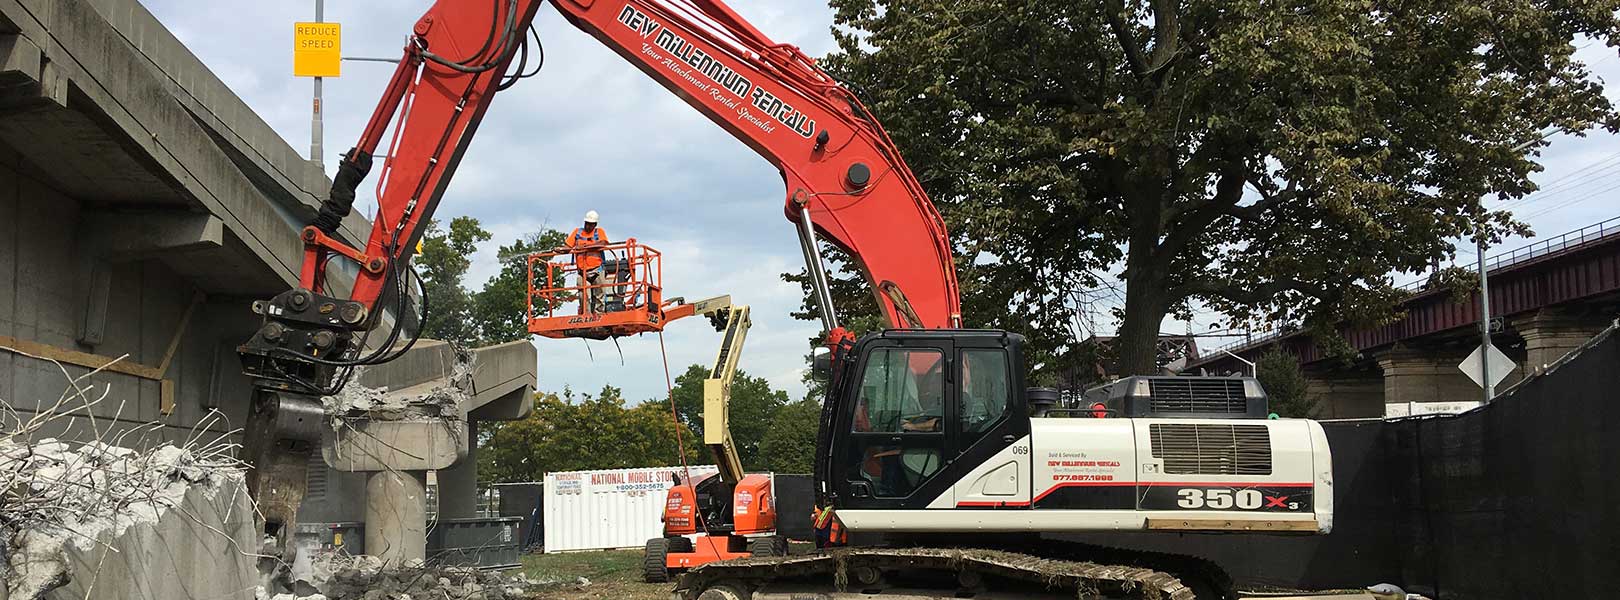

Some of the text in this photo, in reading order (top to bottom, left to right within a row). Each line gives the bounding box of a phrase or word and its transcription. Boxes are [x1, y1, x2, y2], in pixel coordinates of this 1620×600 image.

[297, 26, 337, 36] REDUCE
[301, 39, 334, 48] SPEED
[617, 4, 816, 138] NEW MILLENNIUM RENTALS
[641, 42, 776, 134] Your Attachment Rental Specialist
[1012, 445, 1028, 455] 069
[591, 473, 625, 485] NATIONAL
[628, 471, 653, 484] MOBILE
